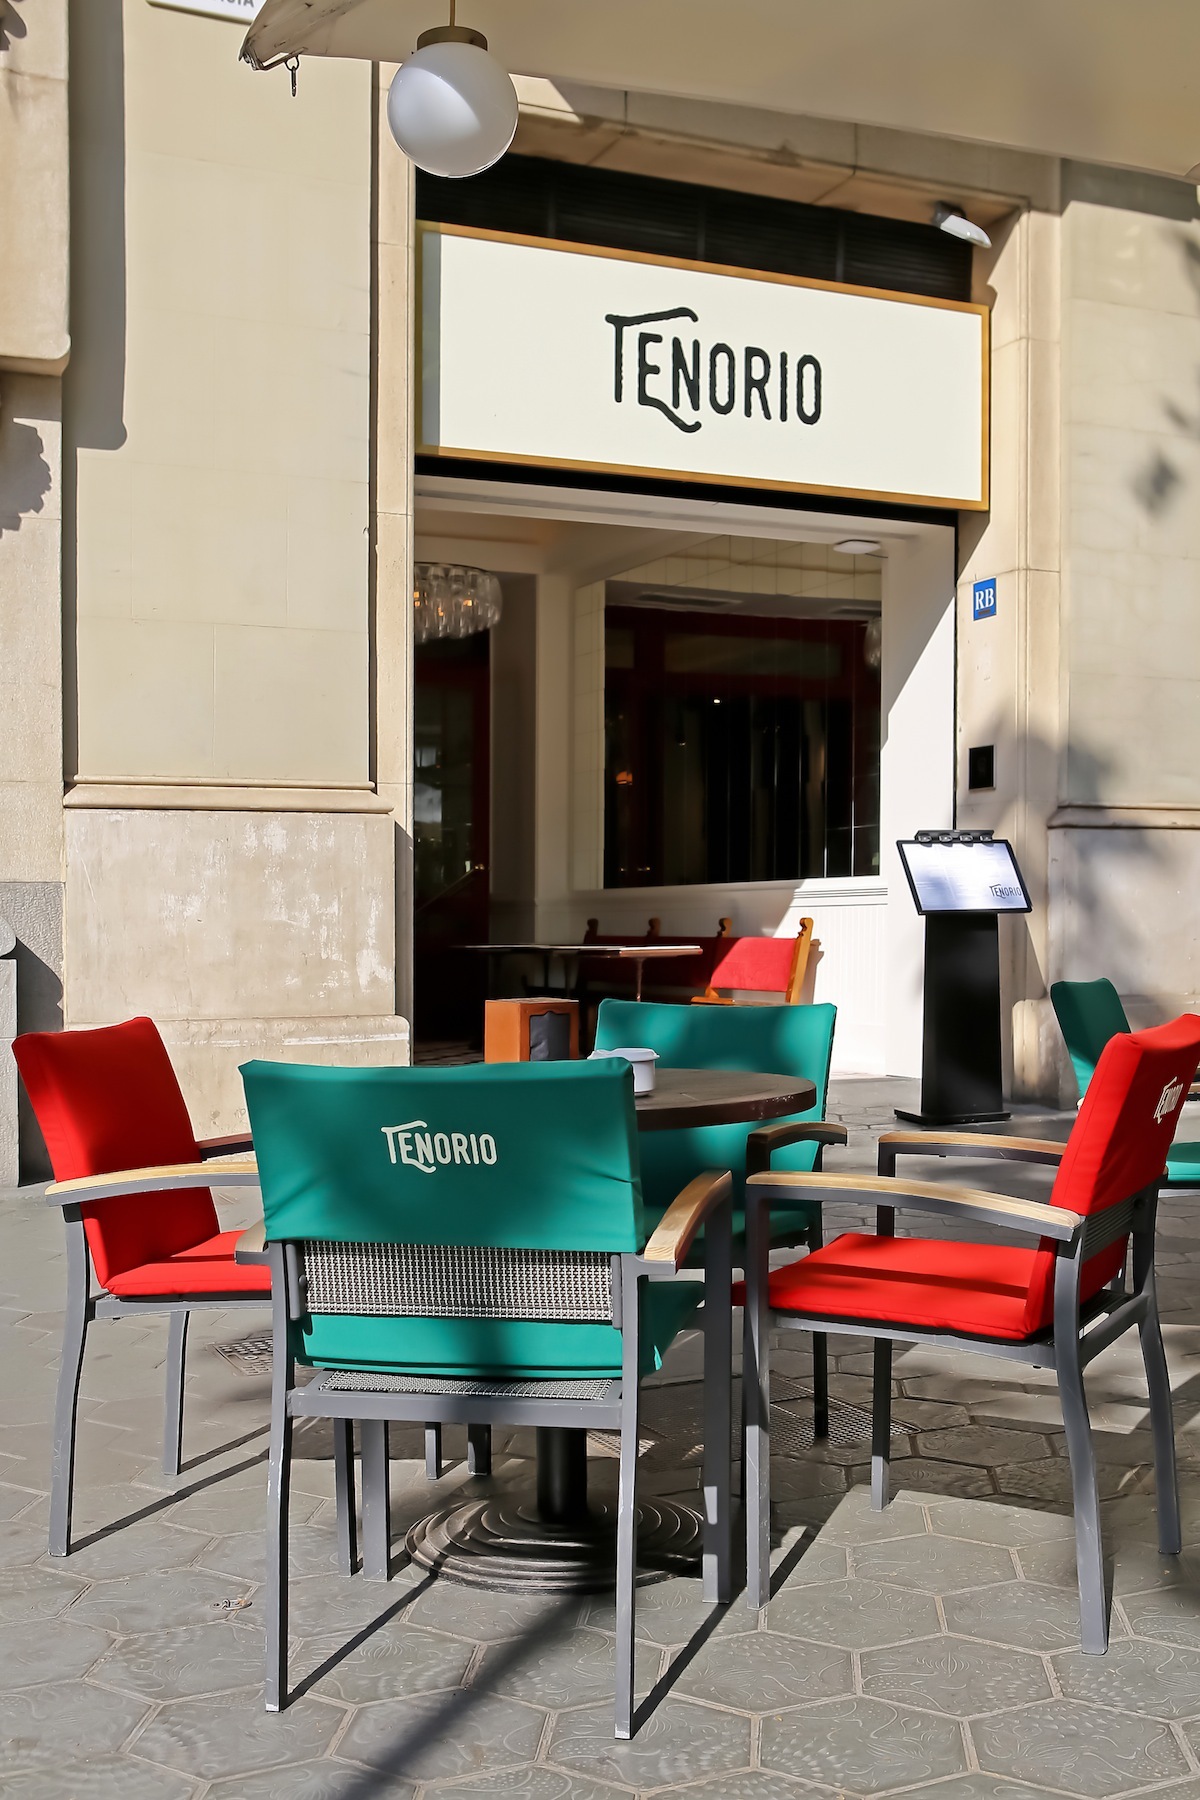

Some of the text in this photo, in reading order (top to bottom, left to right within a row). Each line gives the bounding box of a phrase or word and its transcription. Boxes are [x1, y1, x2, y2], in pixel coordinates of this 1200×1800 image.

[605, 307, 822, 433] TENORIO
[975, 588, 995, 611] RB
[989, 883, 1022, 899] TENORIO
[380, 1120, 498, 1174] TENORIO
